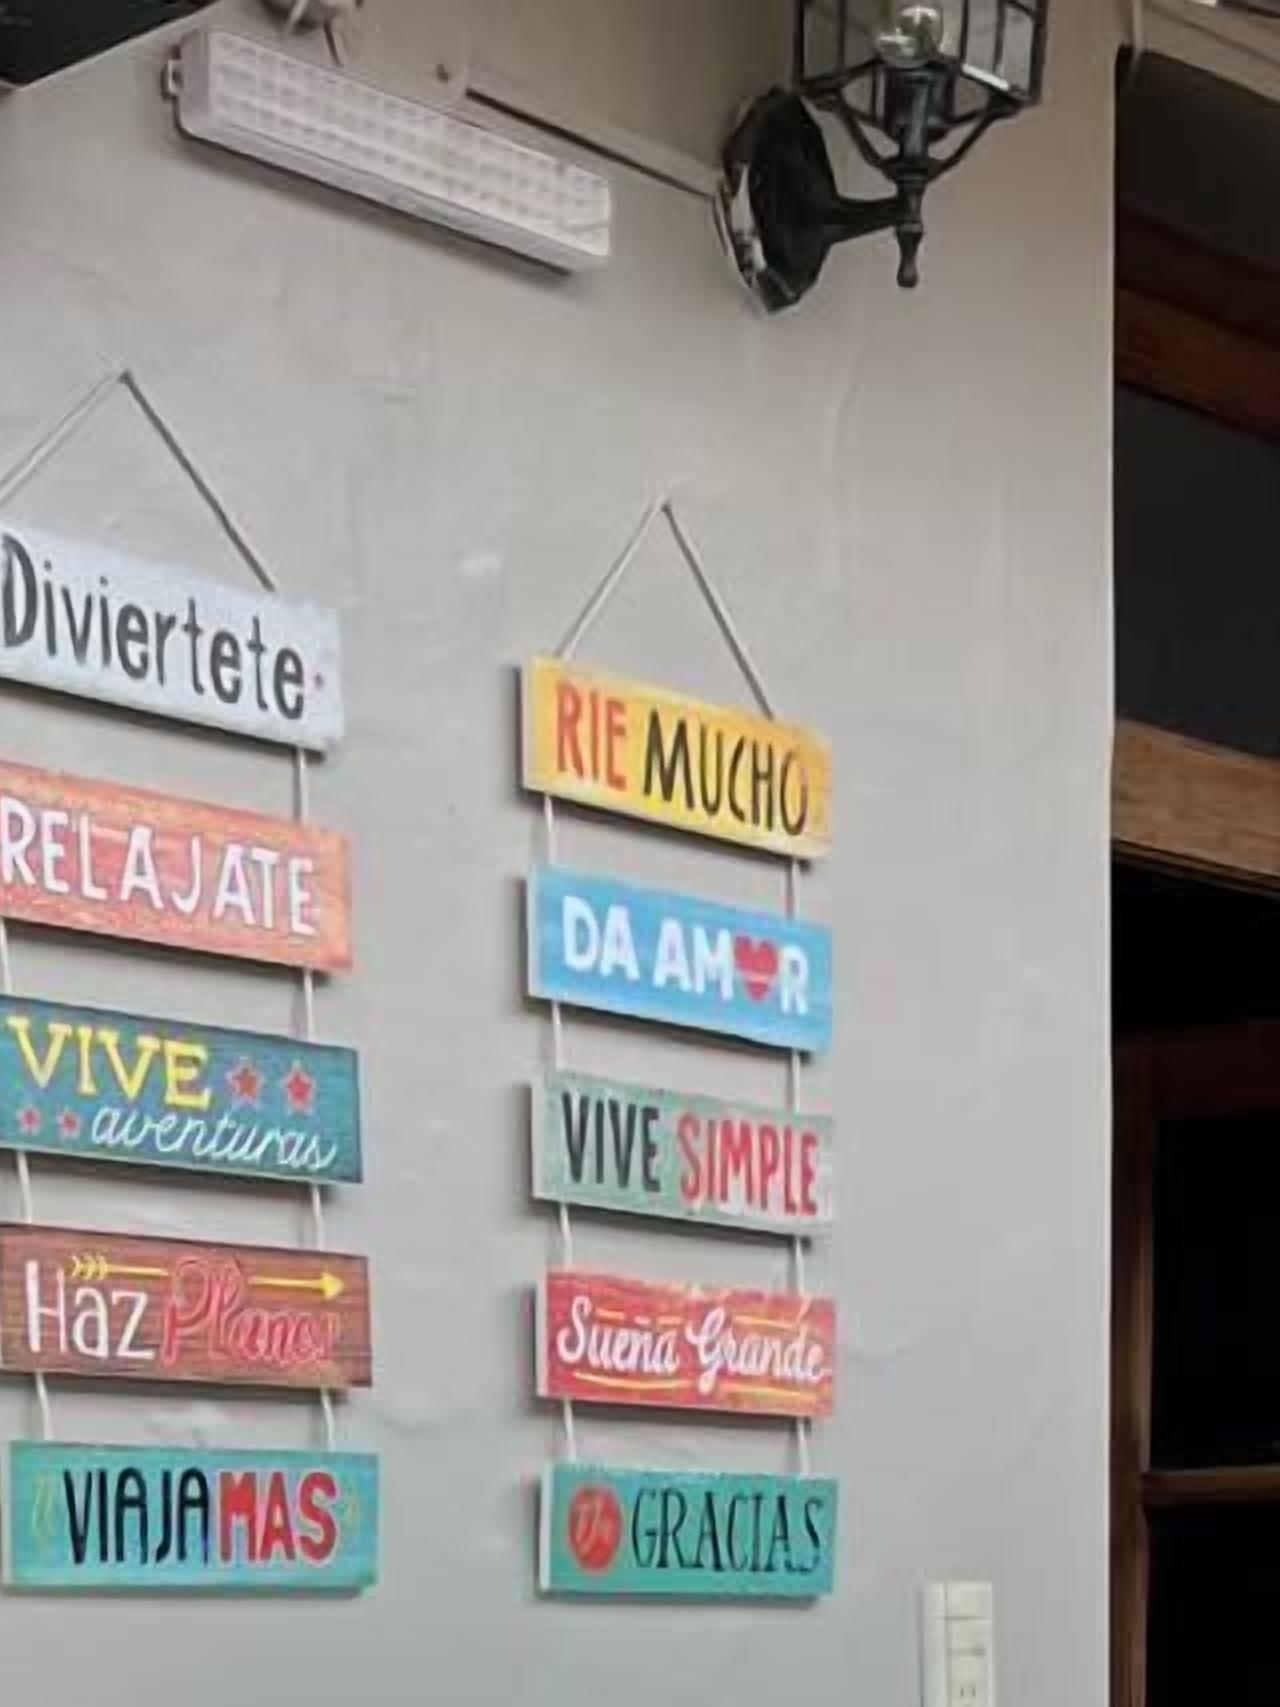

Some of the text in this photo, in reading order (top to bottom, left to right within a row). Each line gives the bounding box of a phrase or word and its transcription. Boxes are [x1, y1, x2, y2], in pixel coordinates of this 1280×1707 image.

[0, 531, 306, 721] Diviertete
[556, 678, 809, 836] RIE MUCHO
[562, 895, 640, 980] DA
[6, 1015, 213, 1112] VIVE
[91, 1105, 337, 1172] aventuras
[562, 1092, 817, 1217] VIVE SIMPLE
[25, 1259, 155, 1360] Haz
[685, 1306, 832, 1396] Grande
[63, 1468, 339, 1566] VIAJA MAS
[631, 1488, 825, 1574] GRACIAS
